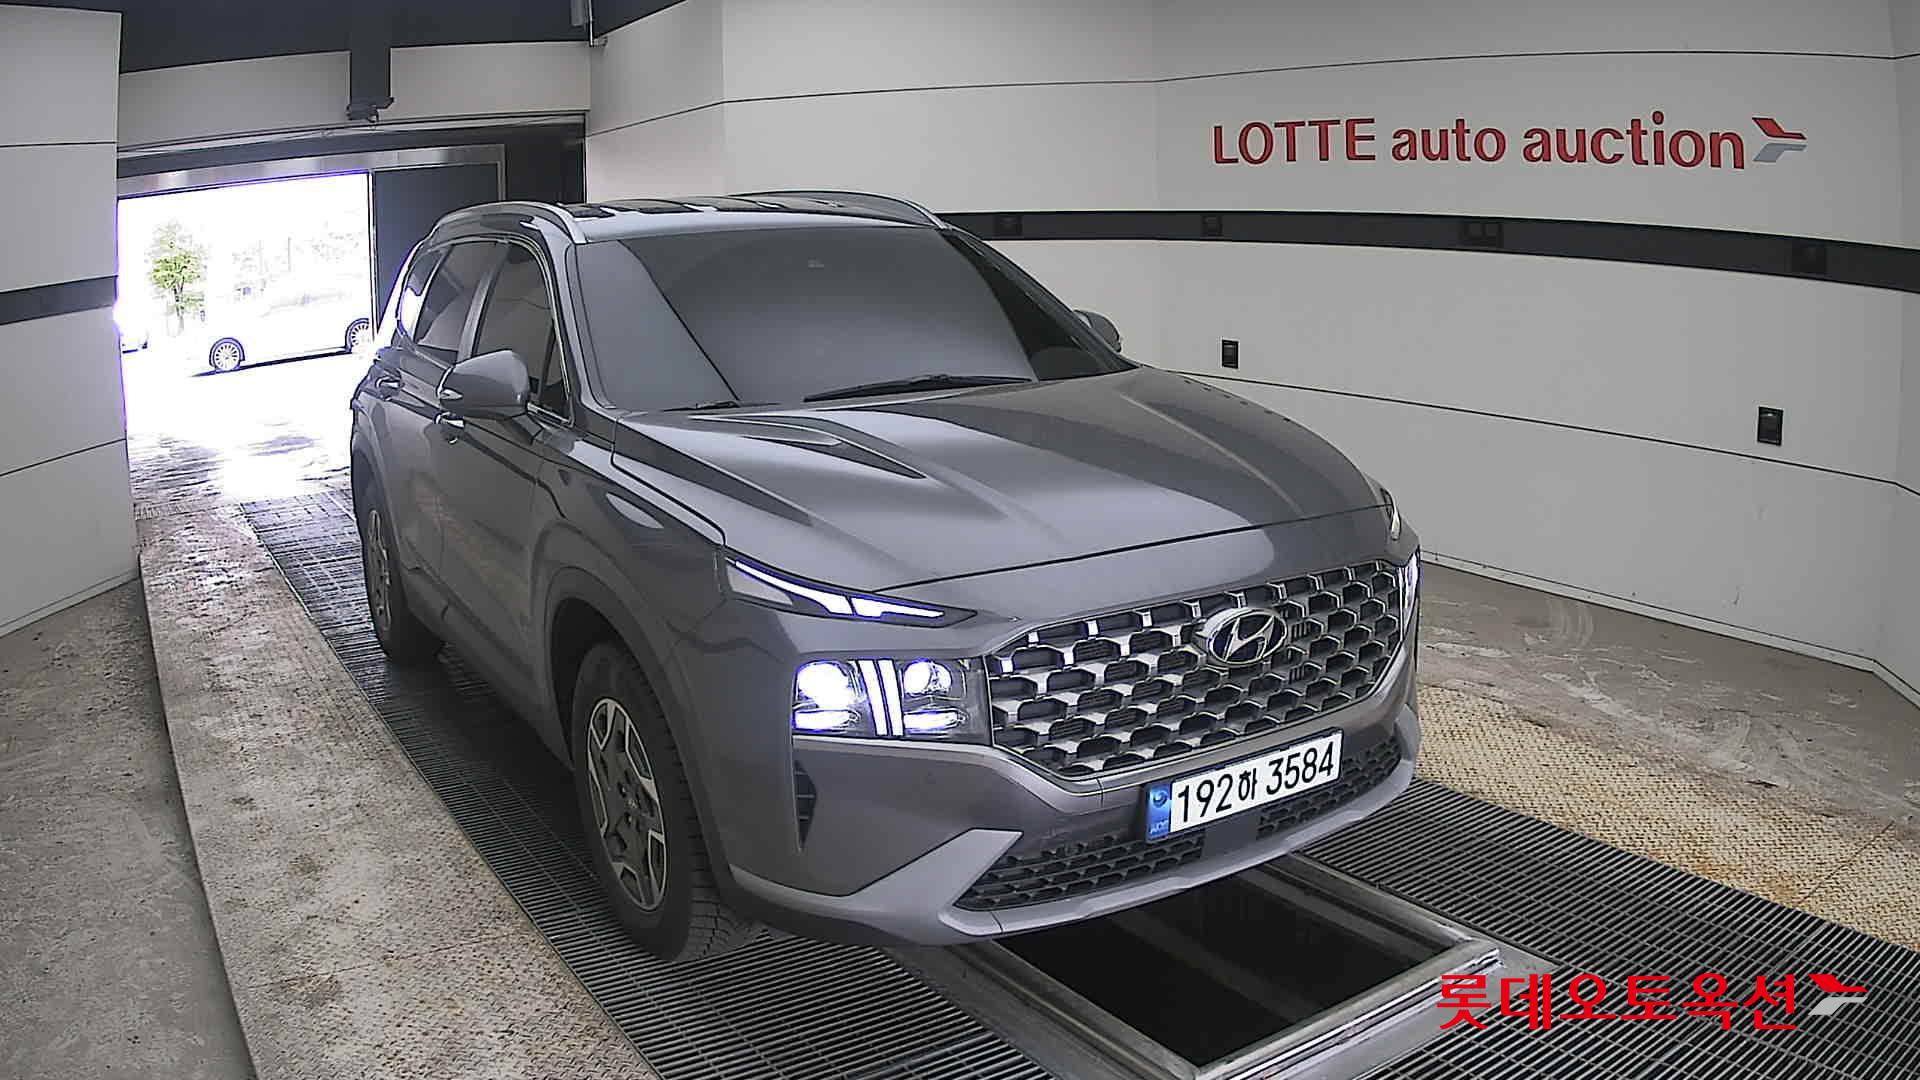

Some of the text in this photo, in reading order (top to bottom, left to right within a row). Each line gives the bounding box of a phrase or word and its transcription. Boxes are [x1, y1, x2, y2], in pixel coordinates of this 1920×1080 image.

[1212, 110, 1746, 170] LOTTE auto auction
[1177, 741, 1335, 823] 192하 3584
